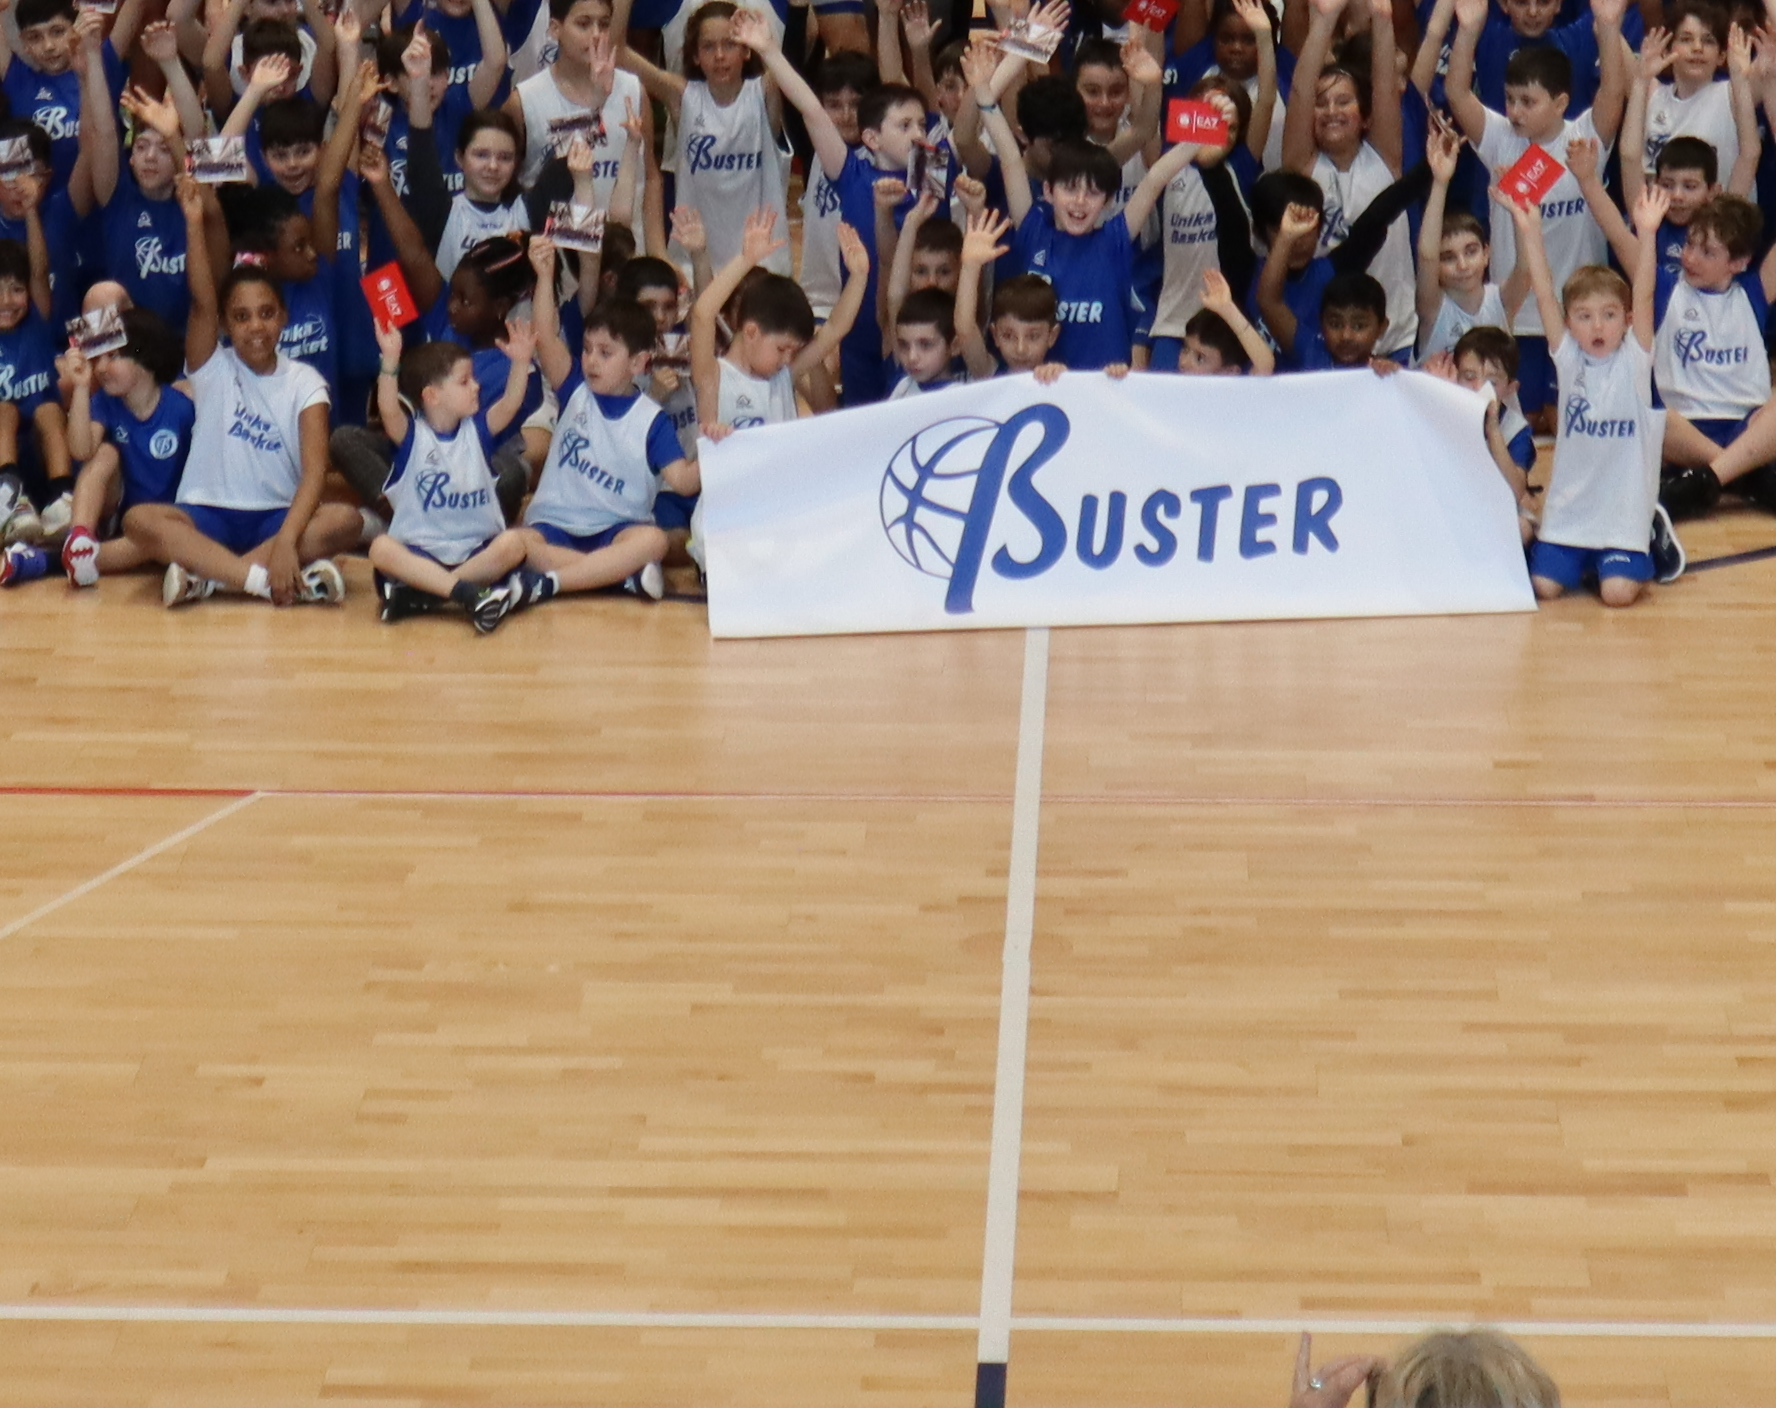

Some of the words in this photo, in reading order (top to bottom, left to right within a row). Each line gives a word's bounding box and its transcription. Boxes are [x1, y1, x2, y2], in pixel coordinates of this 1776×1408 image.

[1197, 114, 1219, 129] EA7
[1540, 198, 1585, 219] USTER
[1171, 212, 1214, 229] Unika
[1171, 230, 1217, 245] Baske
[1570, 396, 1636, 439] BUSTER
[561, 432, 624, 496] BUSTER
[944, 403, 1343, 614] BUSTER
